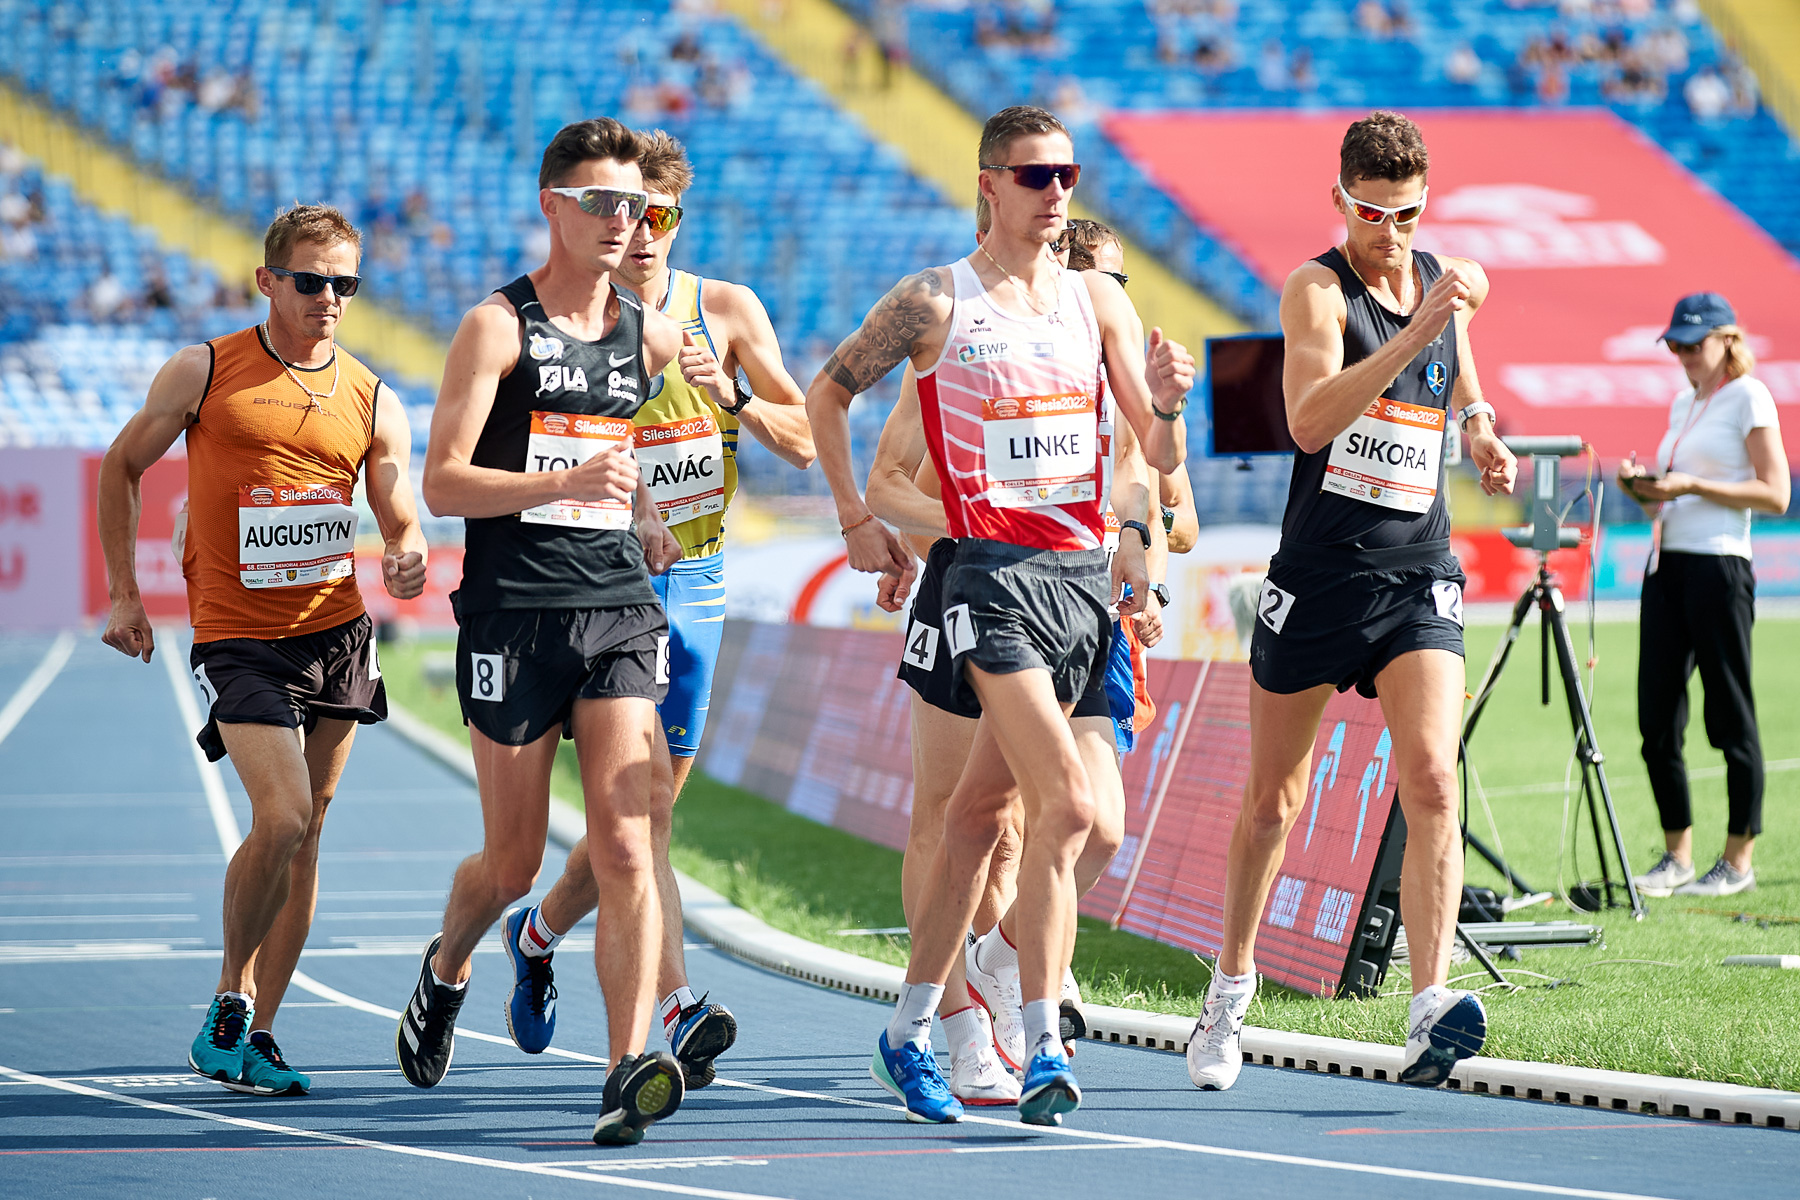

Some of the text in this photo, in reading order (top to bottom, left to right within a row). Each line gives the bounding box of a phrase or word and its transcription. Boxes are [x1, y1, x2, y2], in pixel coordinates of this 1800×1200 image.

[978, 343, 1008, 355] EWP
[1025, 396, 1088, 413] Silesia2022
[1384, 404, 1440, 426] Silesia2022
[574, 420, 627, 436] Silesia2022
[642, 420, 711, 442] Silesia2022
[1009, 433, 1080, 459] LINKE
[1345, 432, 1427, 471] SIKORA
[534, 455, 581, 472] TO
[279, 489, 344, 501] Silesia2022
[245, 520, 352, 548] AUGUSTYN
[1262, 588, 1284, 627] 2
[1444, 584, 1459, 620] 2
[946, 609, 959, 651] 7
[910, 627, 930, 665] 4
[476, 658, 494, 697] 8
